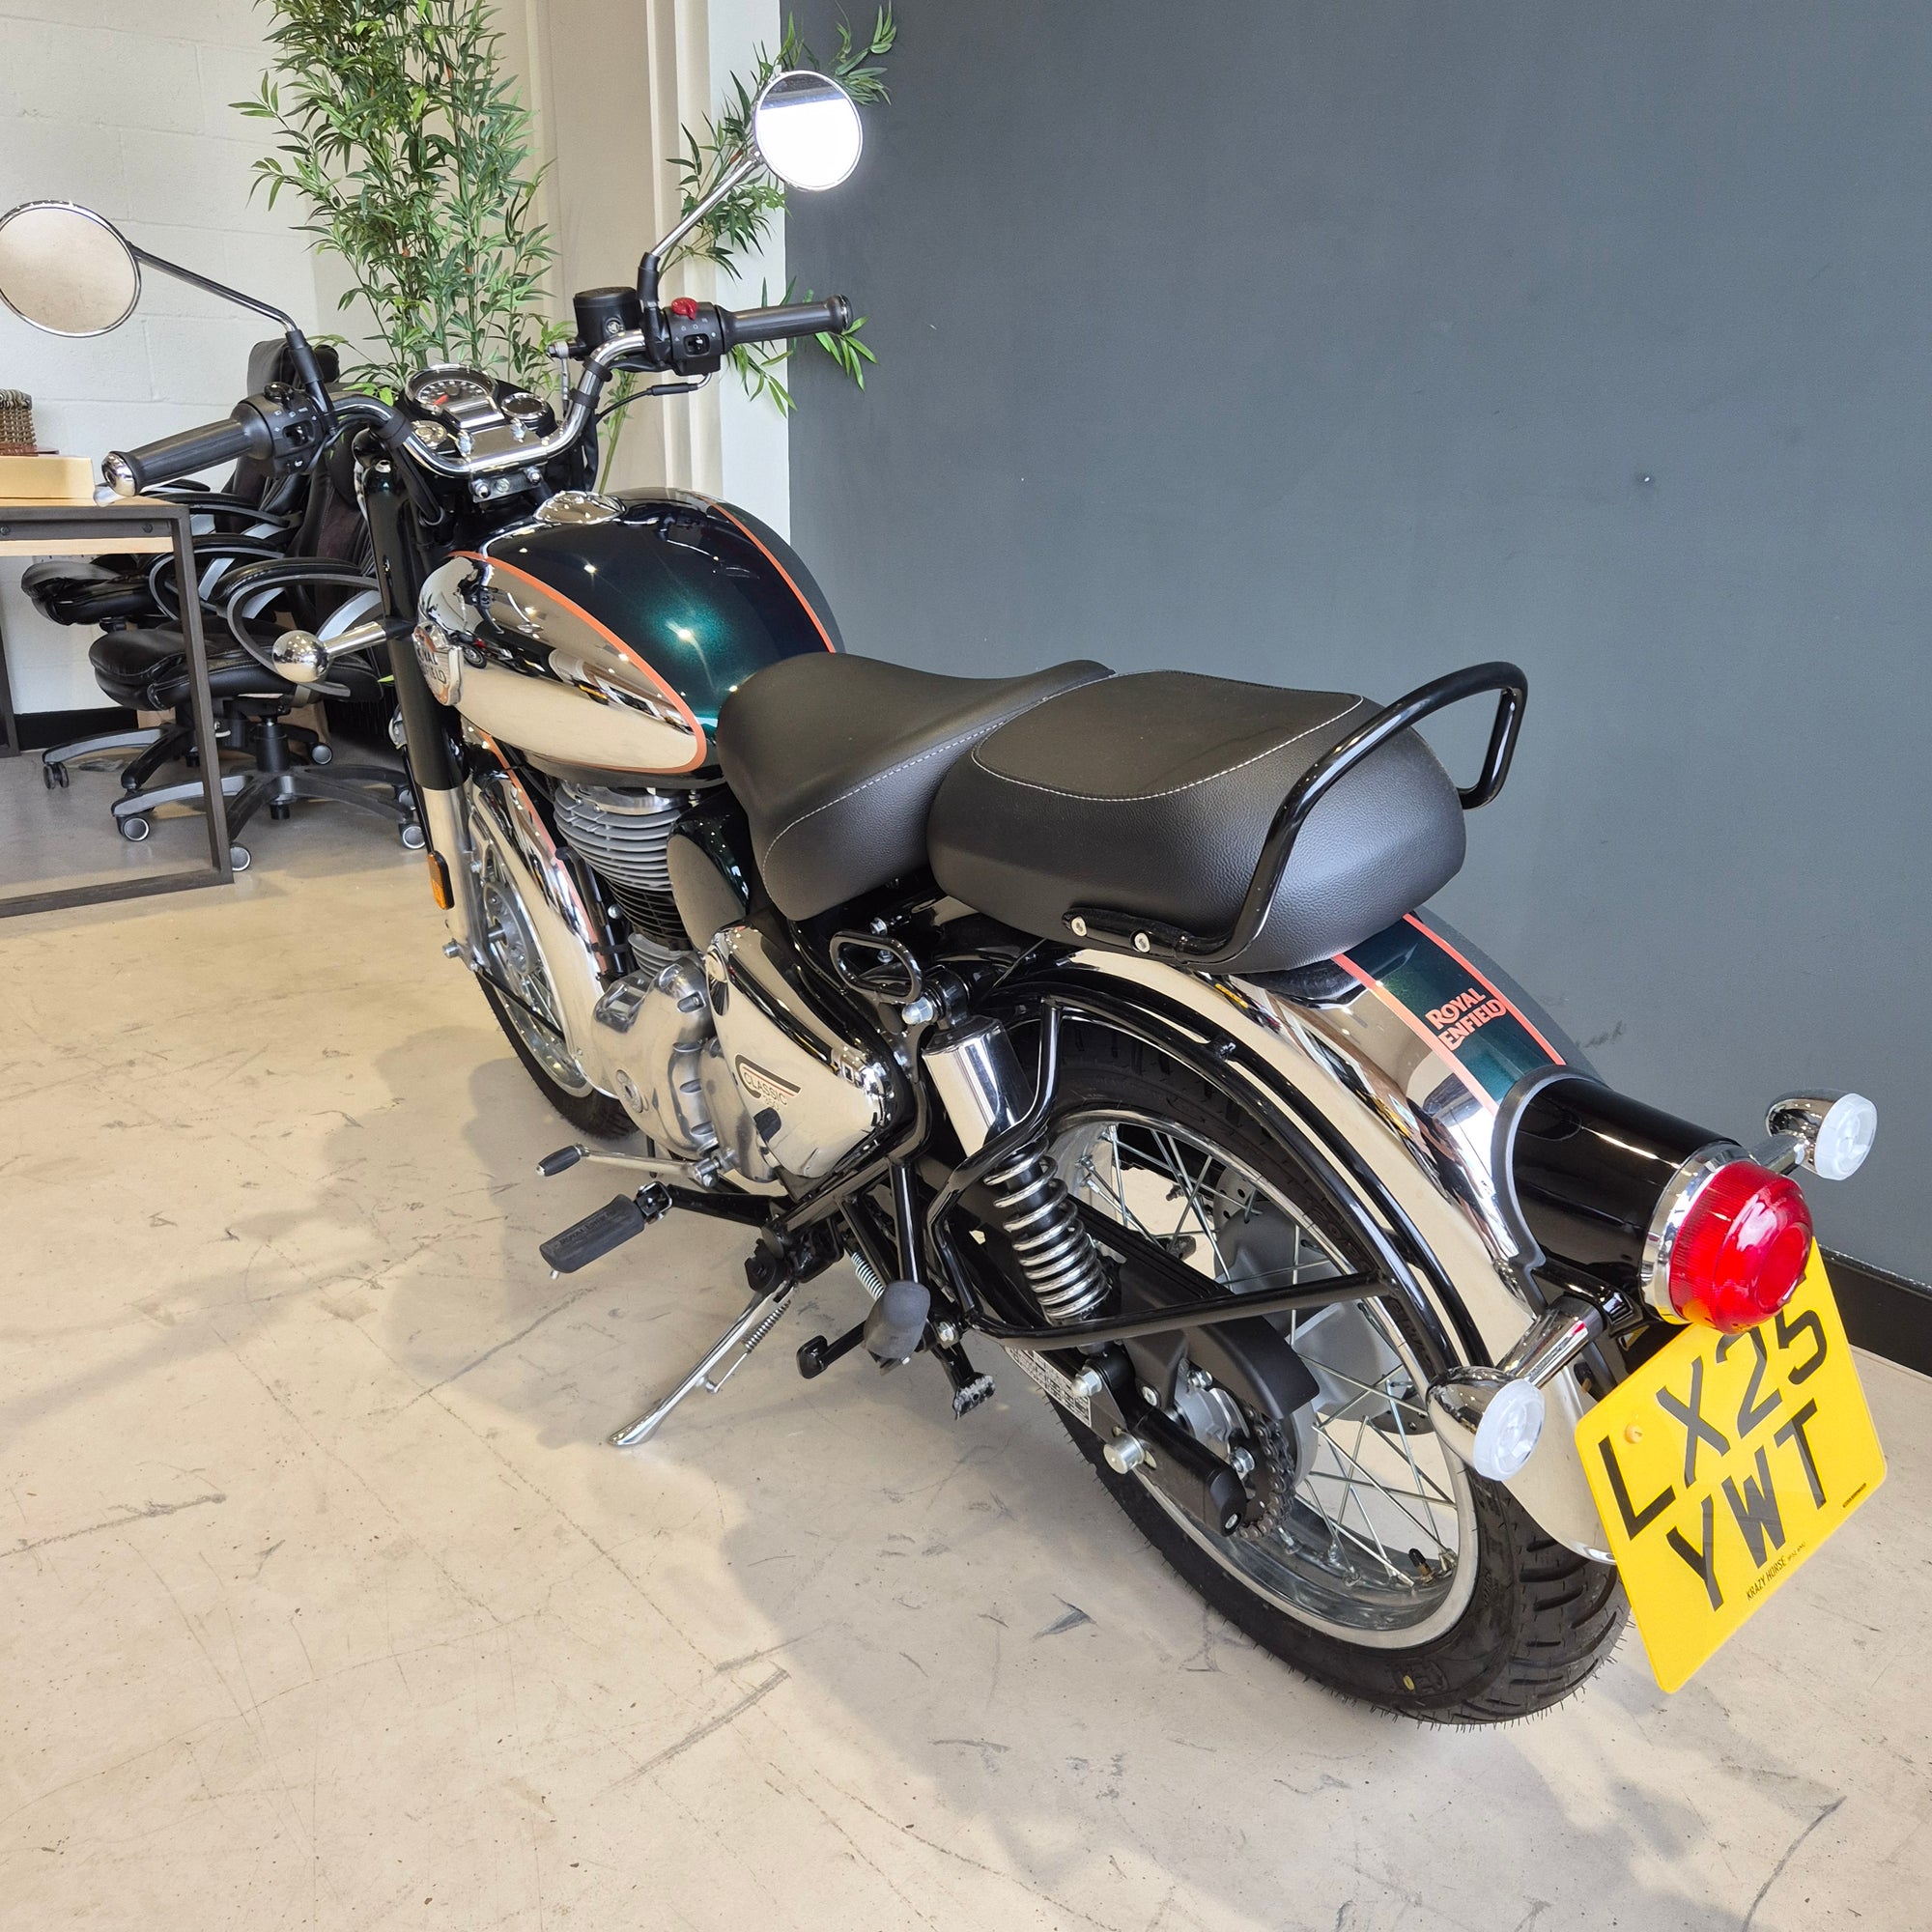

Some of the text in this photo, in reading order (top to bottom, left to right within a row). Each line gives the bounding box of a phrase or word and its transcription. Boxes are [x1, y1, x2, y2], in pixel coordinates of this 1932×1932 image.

[1425, 987, 1486, 1031] ROYAL
[1437, 999, 1507, 1051] ENFIELD
[744, 1071, 787, 1105] CLASSIC
[1599, 1277, 1828, 1541] LX25
[1666, 1398, 1827, 1611] YWT
[1747, 1555, 1786, 1601] KRAZY HORSE
